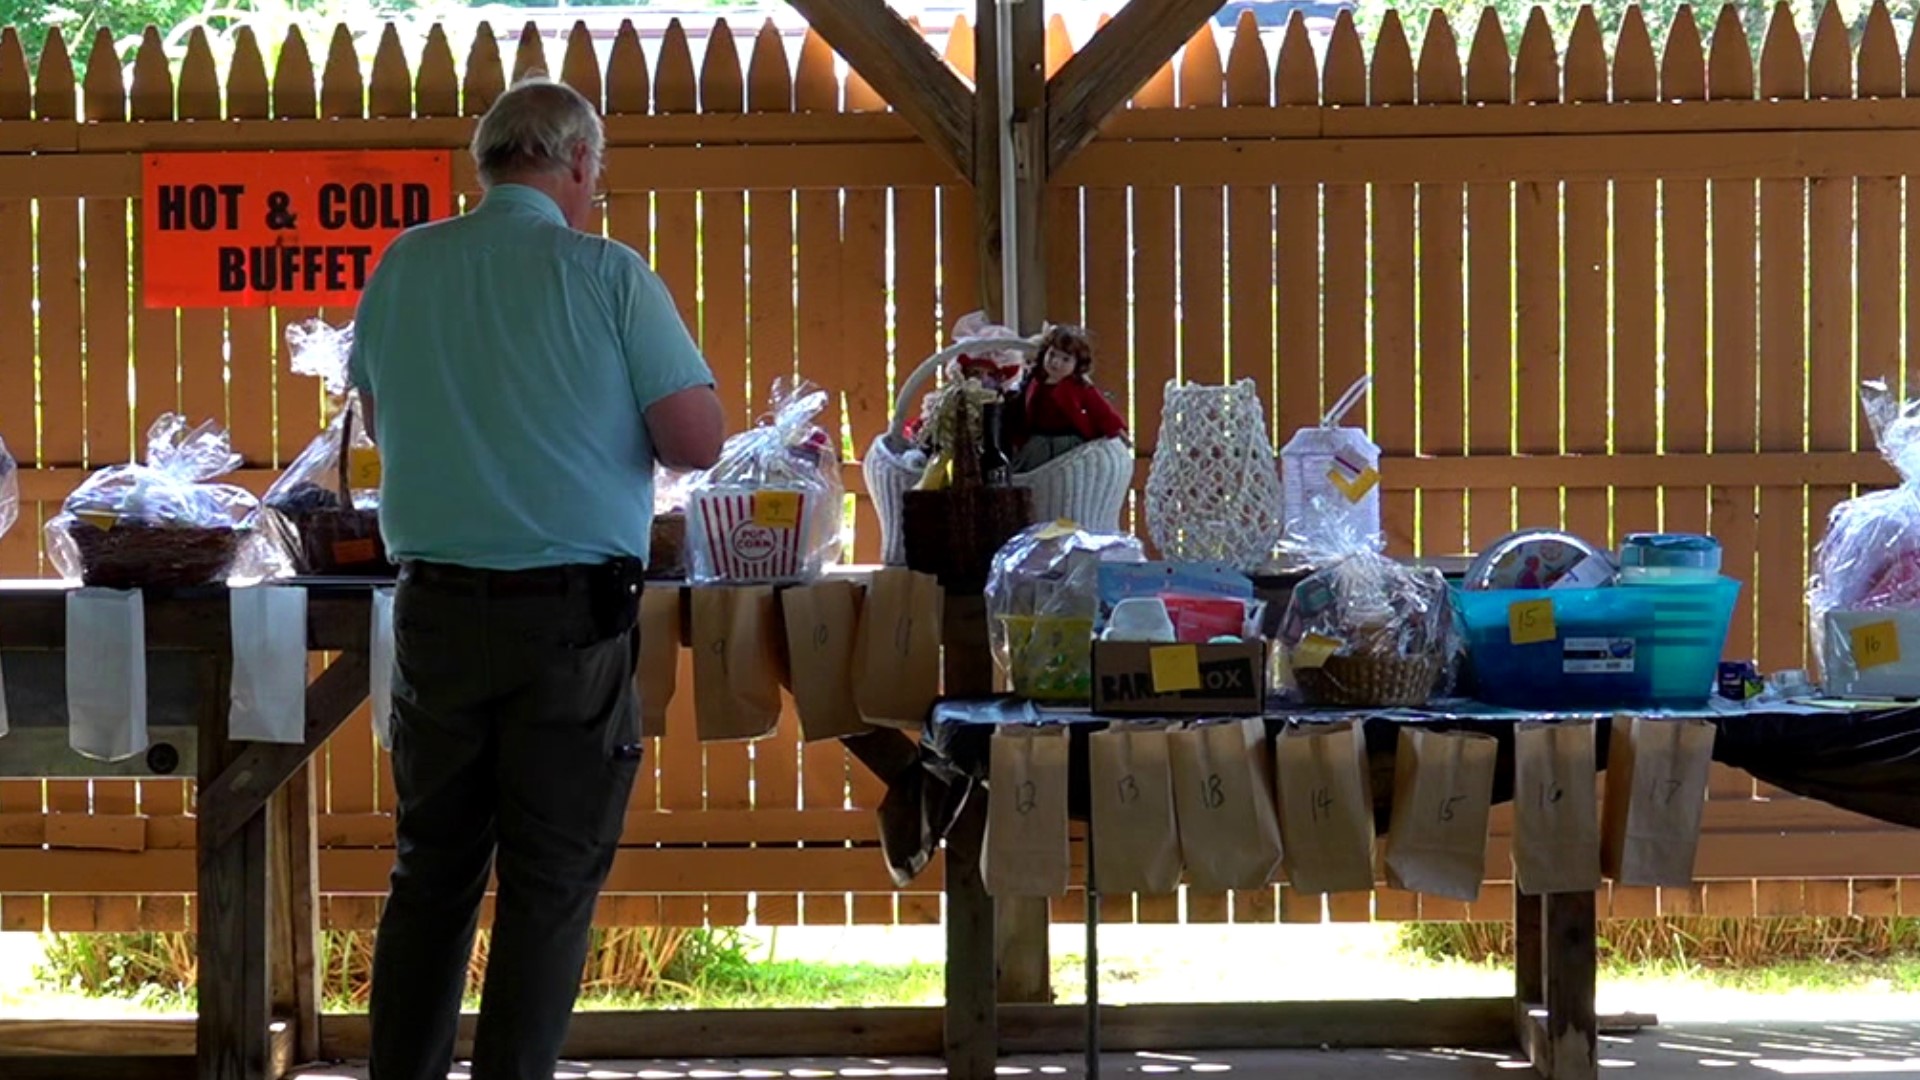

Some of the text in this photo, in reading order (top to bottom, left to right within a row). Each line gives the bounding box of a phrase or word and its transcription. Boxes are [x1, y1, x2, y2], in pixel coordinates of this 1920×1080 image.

[158, 182, 430, 231] HOT & COLD
[219, 246, 372, 293] BUFFET
[736, 538, 772, 550] CORN
[741, 529, 767, 539] POP
[1517, 608, 1538, 631] 15
[813, 623, 829, 653] 10
[1864, 635, 1881, 653] 16
[1015, 780, 1037, 814] 12
[1117, 776, 1140, 804] 13
[1200, 773, 1226, 809] 18
[1310, 786, 1334, 822] 14
[1538, 781, 1563, 808] 16
[1649, 779, 1684, 805] 17
[1437, 794, 1467, 823] 15
